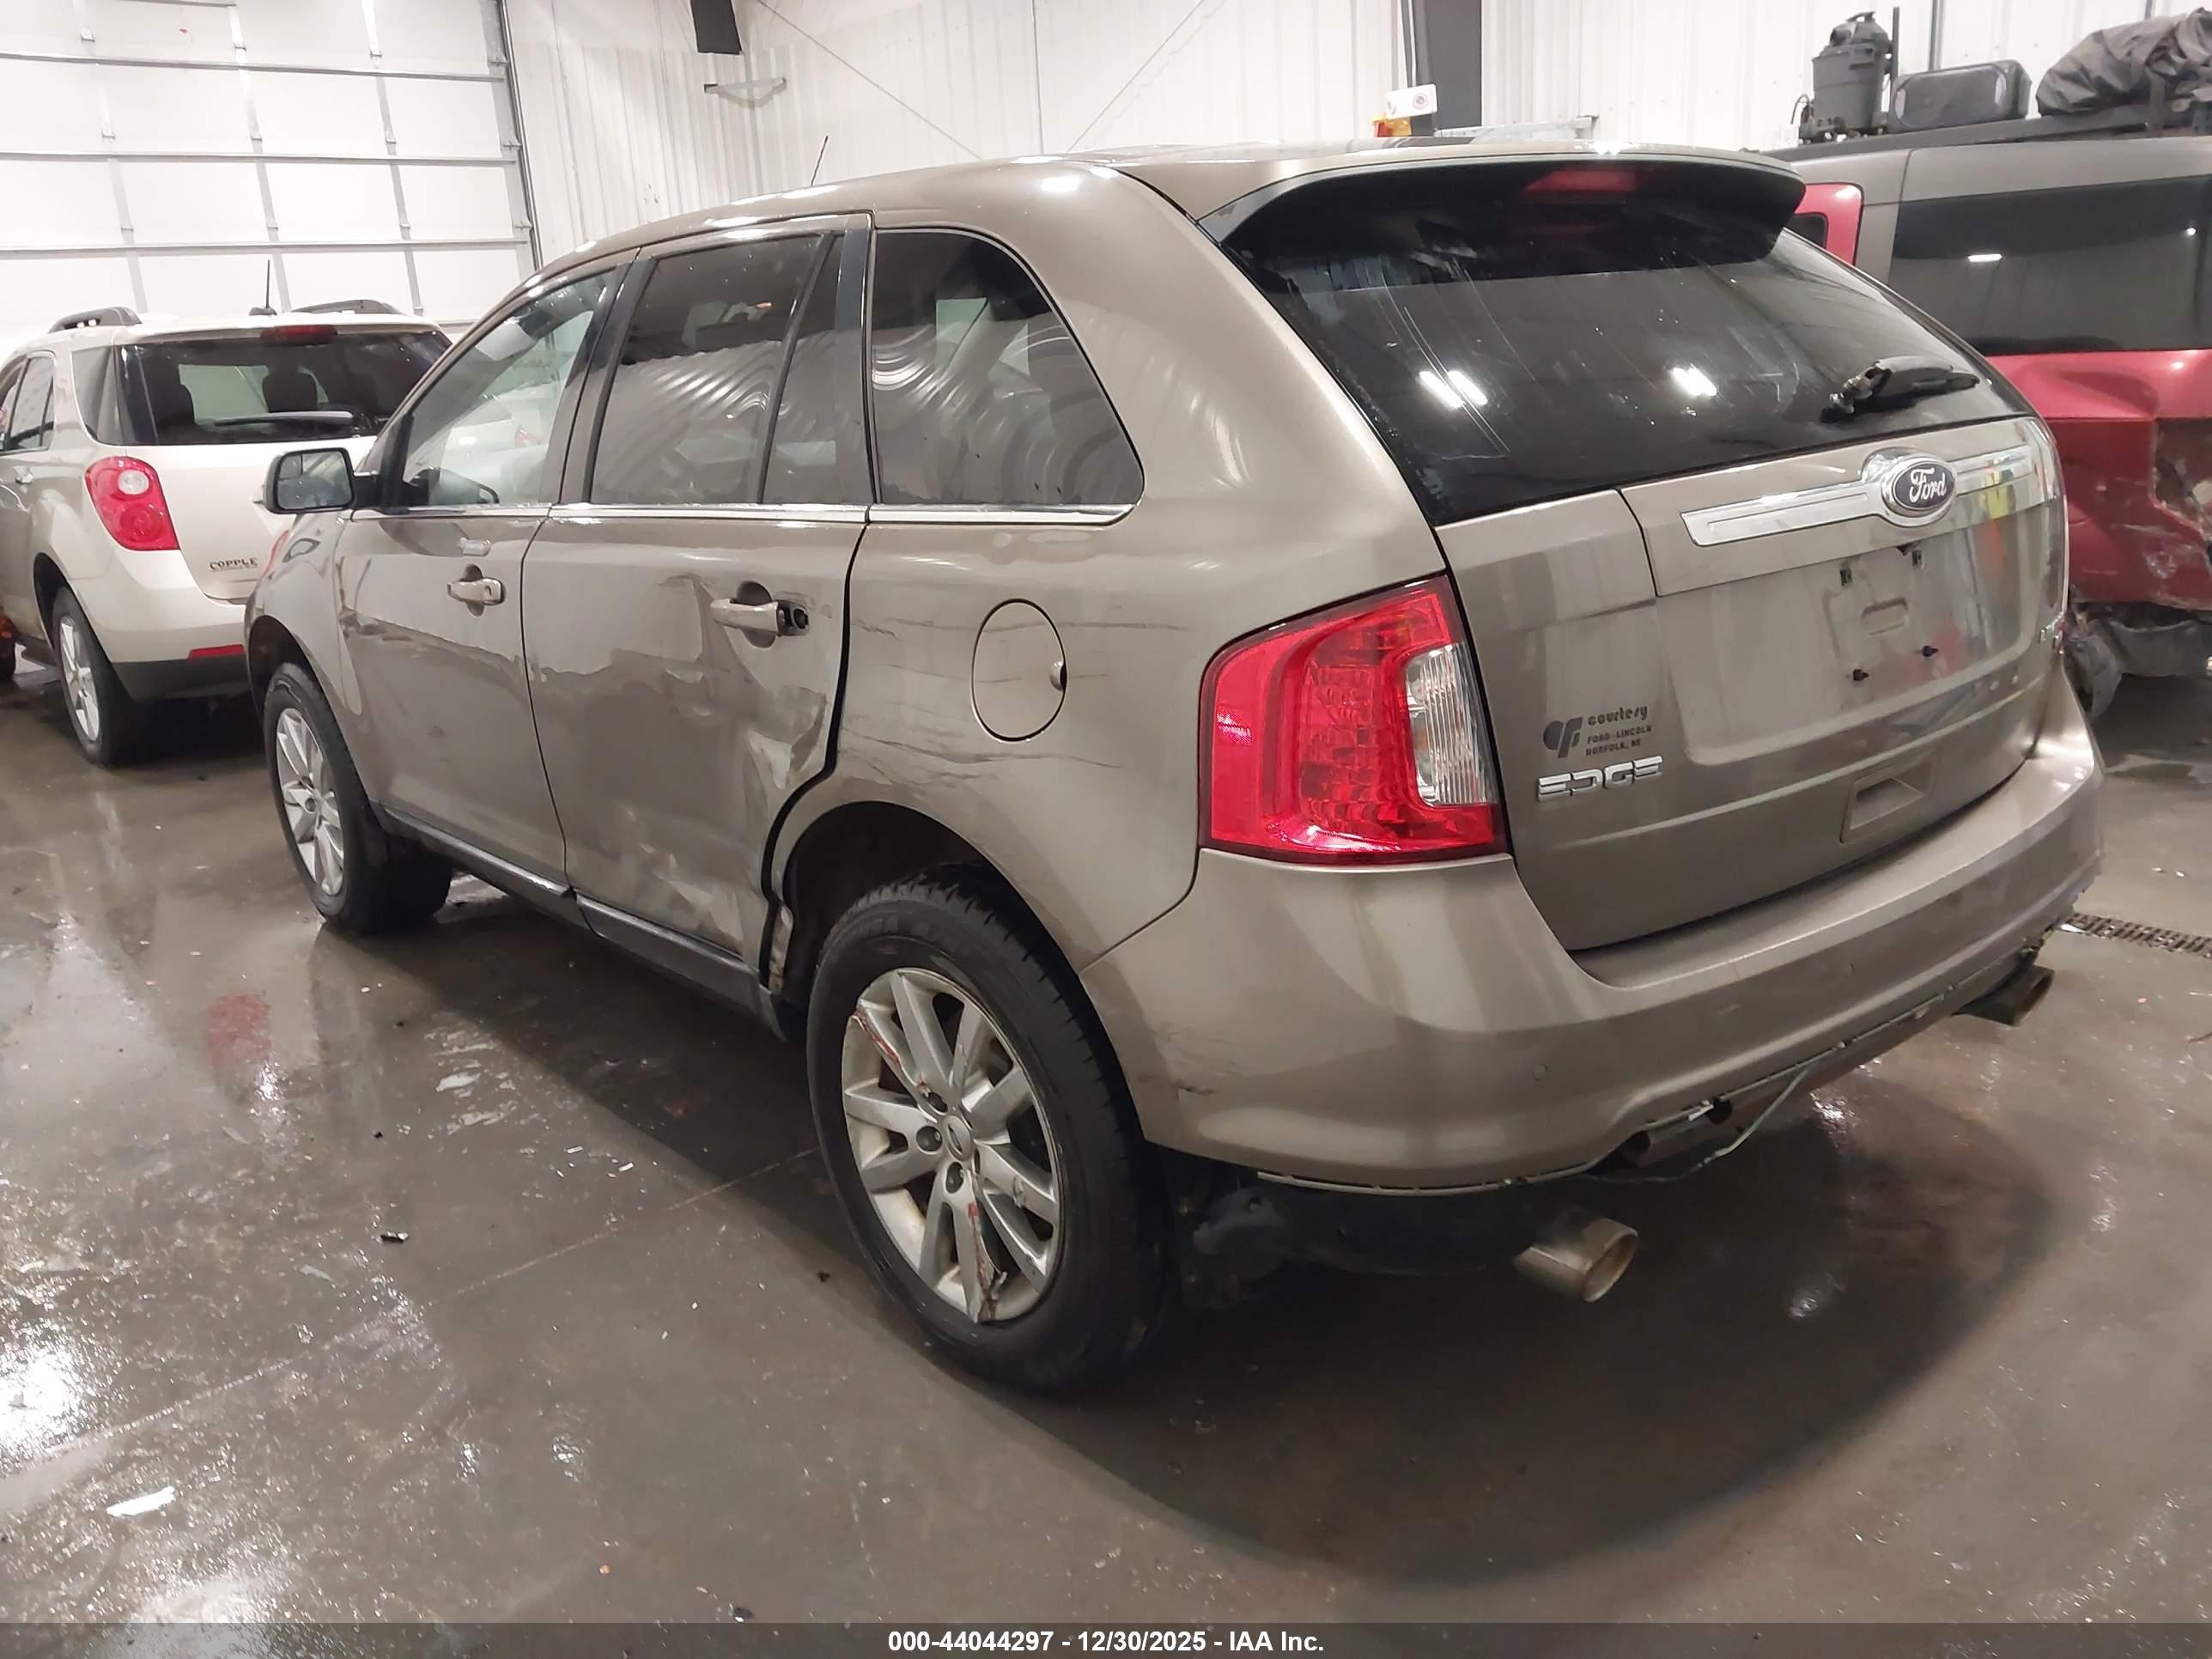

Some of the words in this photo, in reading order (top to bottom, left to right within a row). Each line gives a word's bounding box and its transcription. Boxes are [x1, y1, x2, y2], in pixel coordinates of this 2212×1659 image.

[1908, 468, 1948, 502] Ford
[209, 557, 258, 570] COPPLE
[1587, 706, 1649, 726] courtesy
[1585, 741, 1629, 757] NORFOLK,
[1631, 738, 1641, 748] NE
[1538, 755, 1663, 802] EDGE
